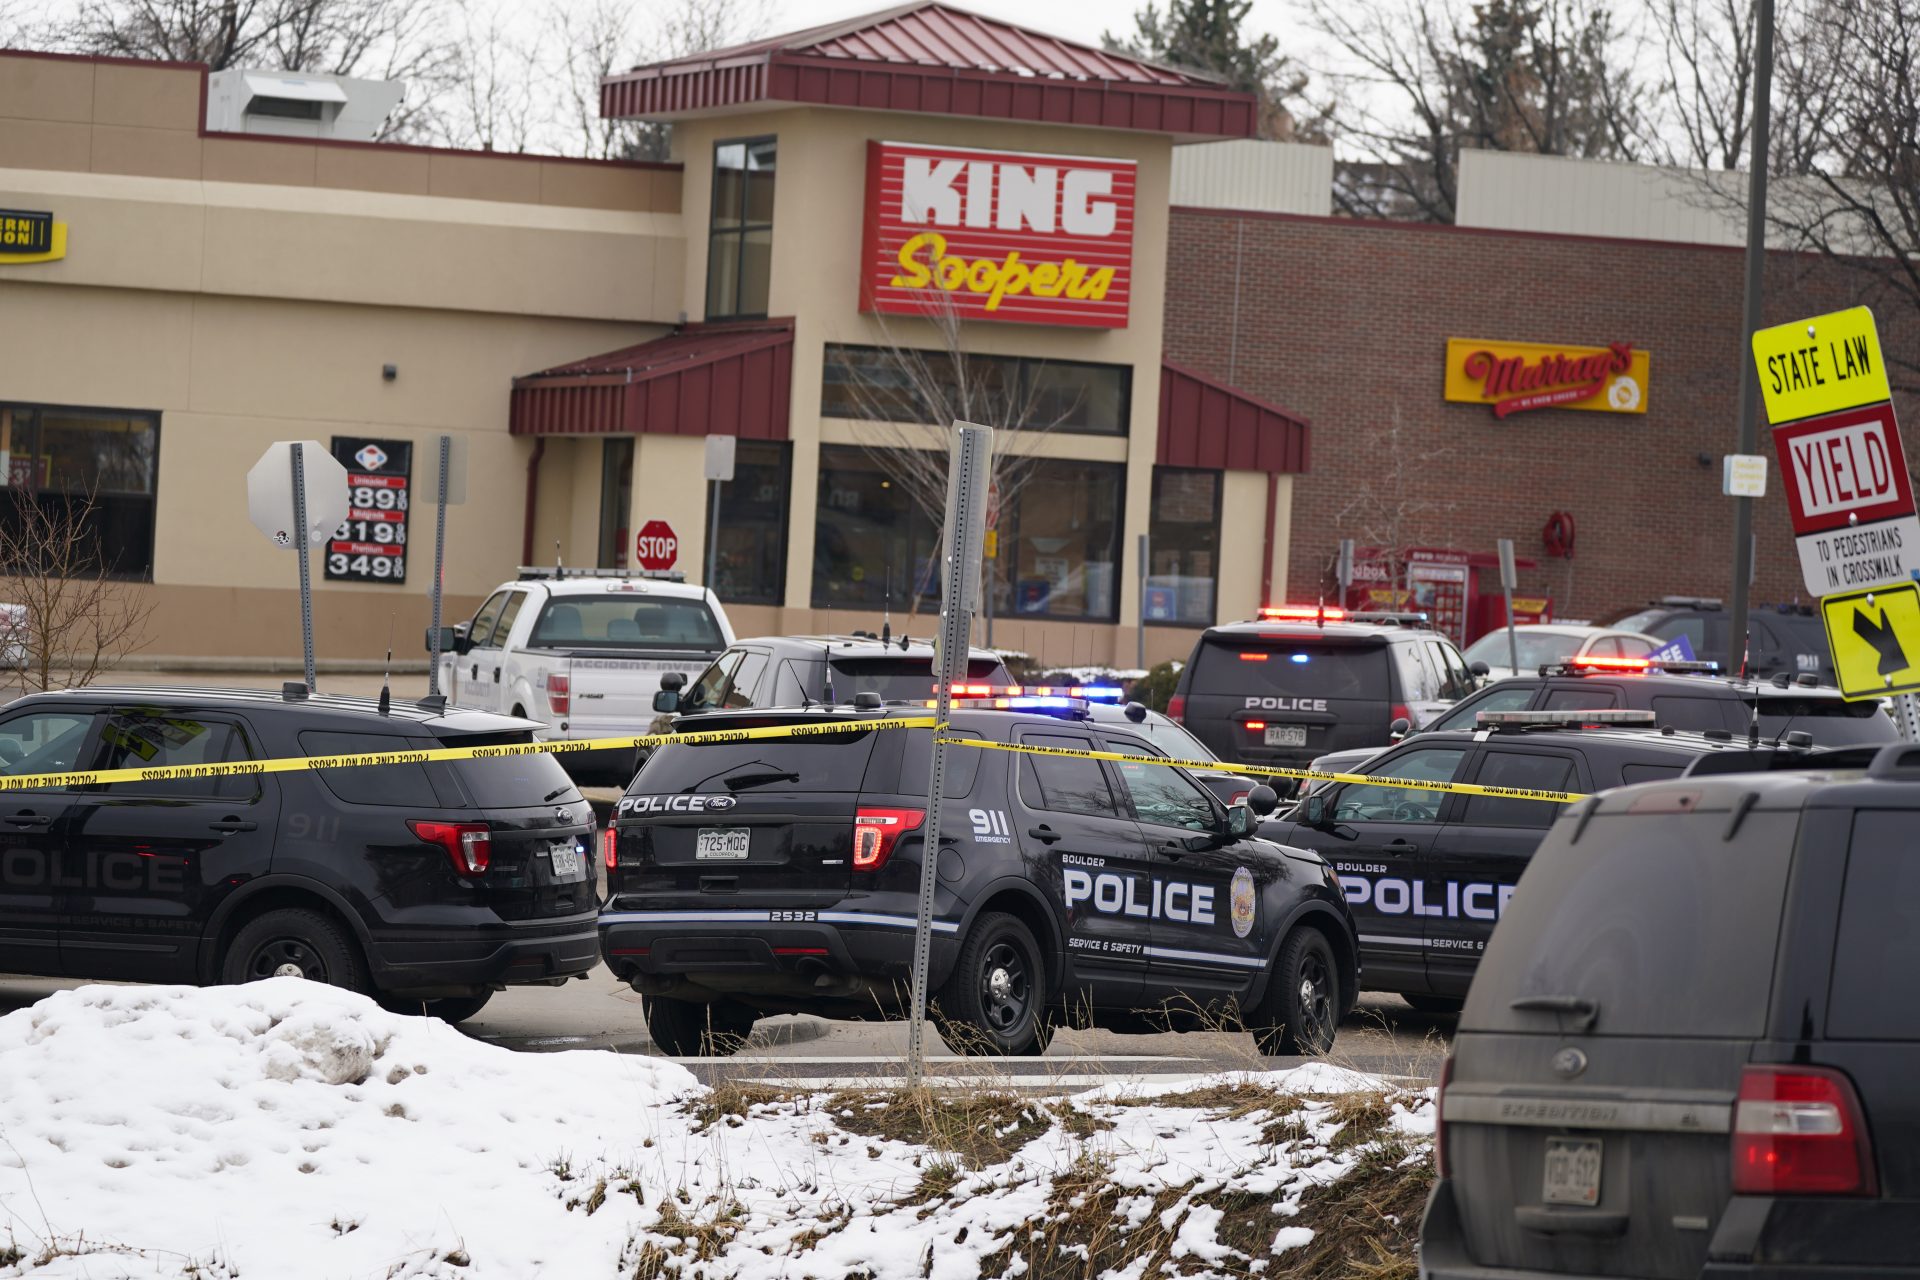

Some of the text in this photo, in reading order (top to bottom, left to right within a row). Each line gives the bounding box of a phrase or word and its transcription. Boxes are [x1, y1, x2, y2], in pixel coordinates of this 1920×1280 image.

[901, 156, 1117, 236] KING
[891, 232, 1115, 310] Soopers
[1465, 342, 1632, 400] Murray's
[1768, 335, 1871, 394] STATE LAW
[1794, 431, 1889, 507] YIELD
[354, 475, 388, 486] Unleaded
[349, 487, 395, 510] 89
[353, 510, 385, 521] Midgrade
[332, 521, 394, 544] 319
[351, 543, 384, 556] Premium
[639, 536, 676, 559] STOP
[1816, 527, 1903, 562] TO PEDESTRIANS
[329, 553, 392, 578] 349
[1352, 562, 1388, 578] dbox
[1827, 555, 1904, 588] IN CROSSWALK
[574, 660, 650, 670] ACCIDENT
[1245, 697, 1328, 712] POLICE
[618, 796, 706, 815] POLICE
[288, 813, 340, 842] 911
[969, 809, 1009, 836] 911
[974, 835, 1011, 844] EMERGENCY
[1062, 854, 1105, 867] BOULDER
[1336, 862, 1387, 873] BOULDER
[1063, 869, 1215, 924] POLICE
[71, 916, 131, 928] SERVICE
[150, 918, 204, 931] SAFETY
[771, 911, 816, 922] 2532
[1069, 937, 1142, 955] SERVICE & SAFETY
[1432, 938, 1473, 949] SERVICE
[1501, 1103, 1618, 1121] EXPEDITION
